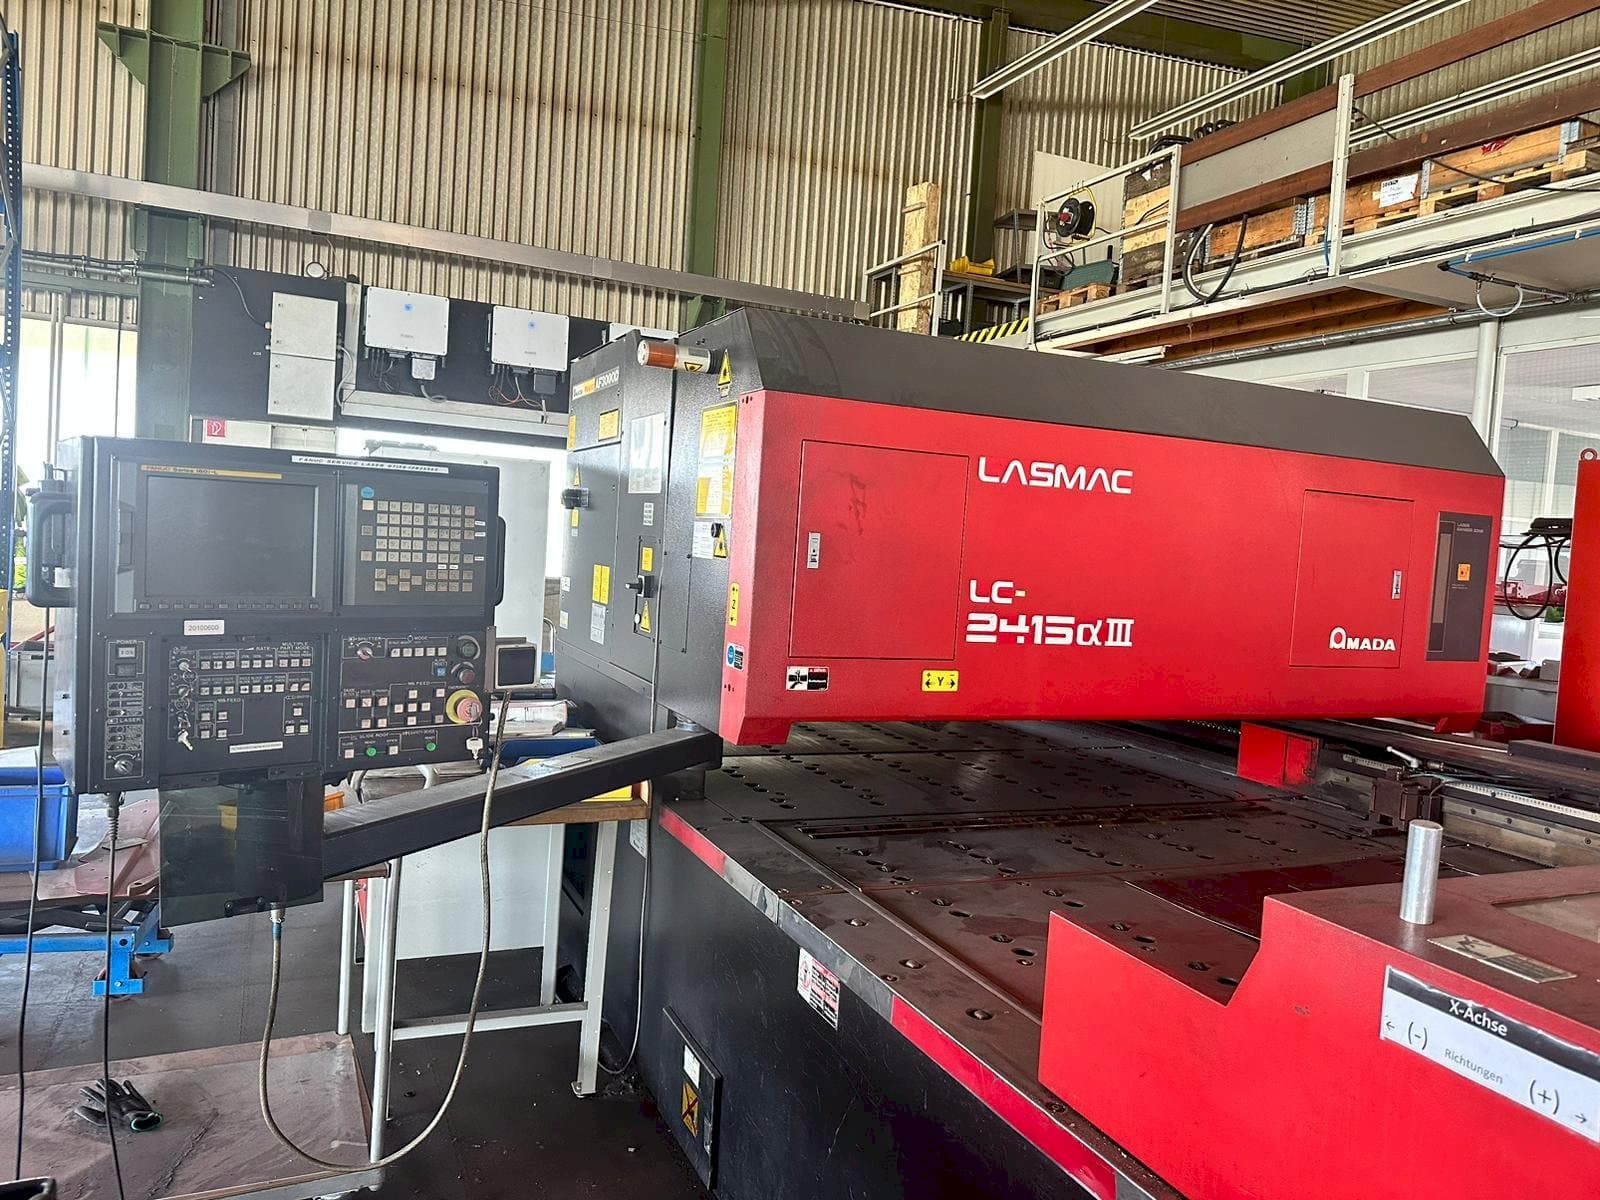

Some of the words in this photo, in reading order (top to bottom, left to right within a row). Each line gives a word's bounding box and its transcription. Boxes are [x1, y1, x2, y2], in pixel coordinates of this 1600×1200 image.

[978, 456, 1134, 494] LASMAC
[969, 579, 1026, 604] LC-
[1329, 627, 1396, 651] AMADA
[937, 676, 944, 686] Y
[1449, 999, 1508, 1036] X-Achse
[1444, 1048, 1503, 1085] Richtungen
